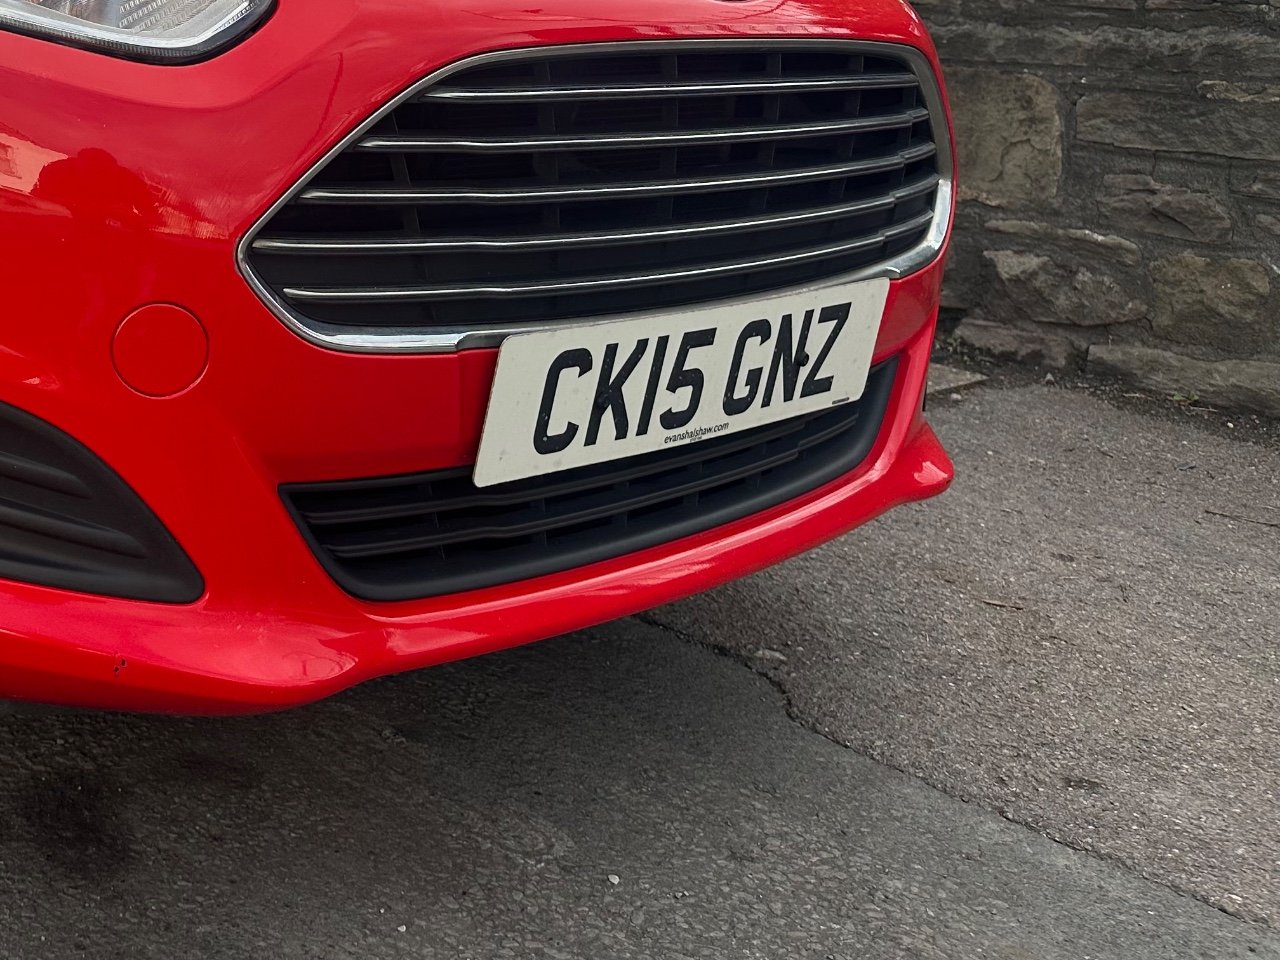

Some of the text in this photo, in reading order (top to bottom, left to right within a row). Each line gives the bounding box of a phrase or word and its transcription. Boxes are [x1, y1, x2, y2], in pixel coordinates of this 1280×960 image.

[532, 302, 853, 456] CK15 GNZ
[663, 422, 730, 444] evanshalshaw.com
